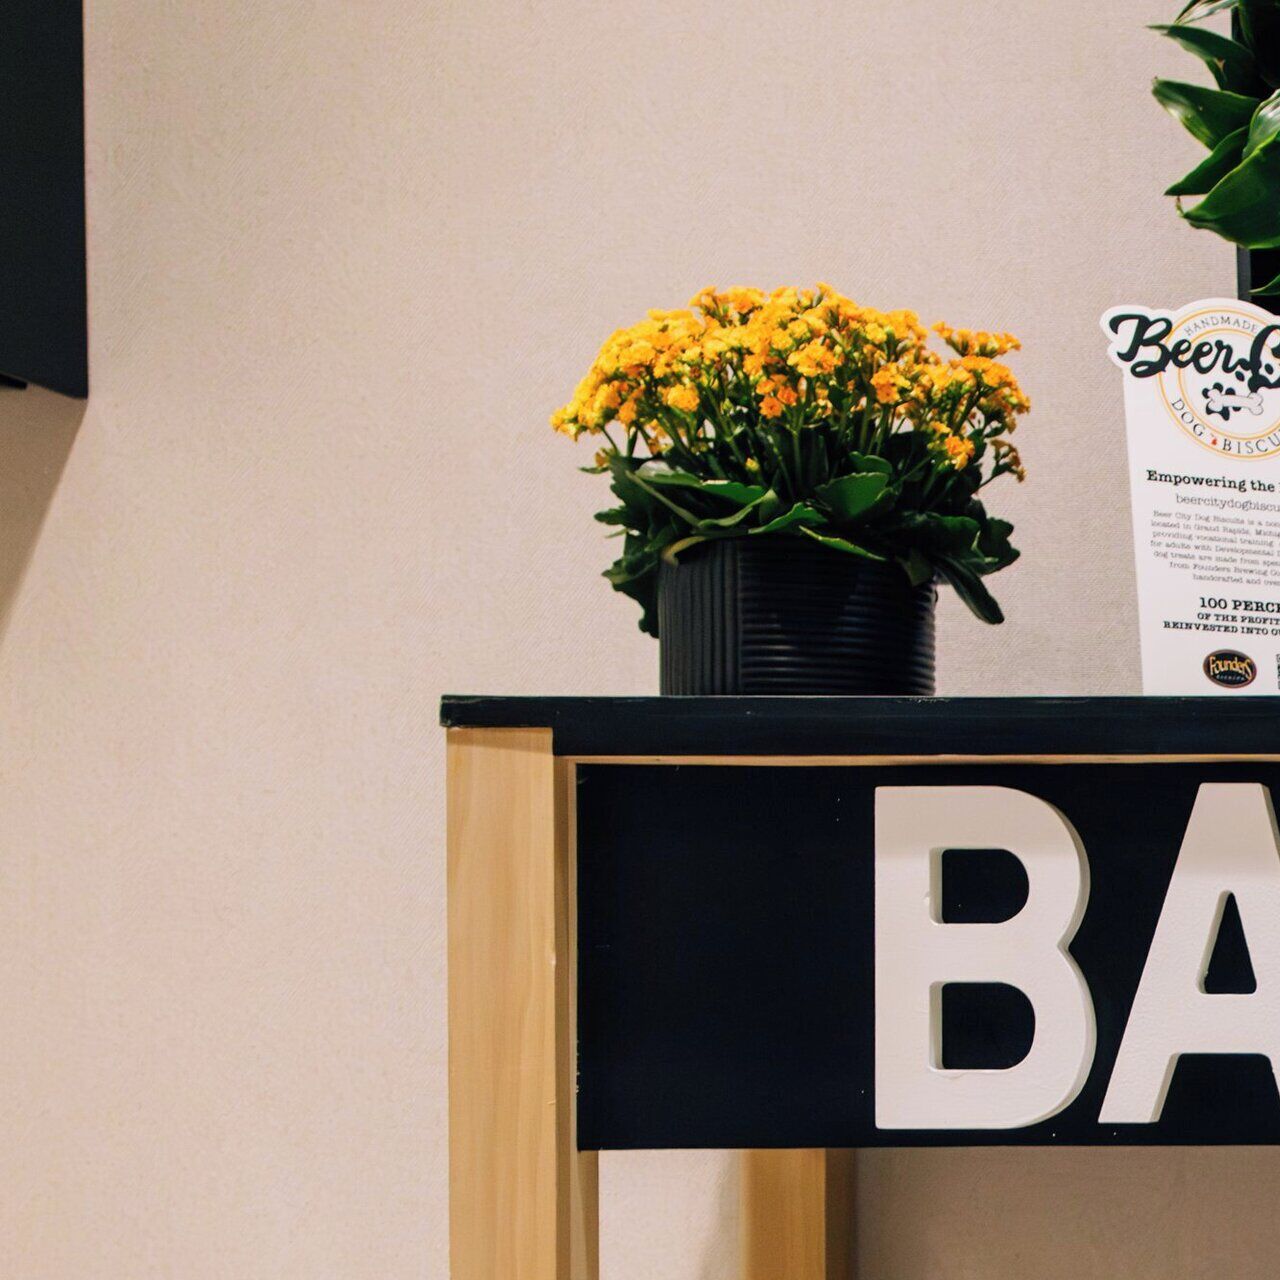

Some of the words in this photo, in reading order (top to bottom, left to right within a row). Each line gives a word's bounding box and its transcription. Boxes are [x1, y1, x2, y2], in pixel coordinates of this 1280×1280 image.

[1184, 315, 1259, 337] HANDMADE
[1109, 313, 1251, 379] Beer
[1170, 398, 1206, 437] DOG
[1146, 469, 1247, 493] Empowering
[1250, 480, 1275, 492] the
[1198, 596, 1228, 611] 100
[1163, 620, 1238, 633] REINVESTED
[1240, 627, 1268, 636] INTO
[1197, 612, 1211, 621] OF
[1214, 613, 1238, 623] THE
